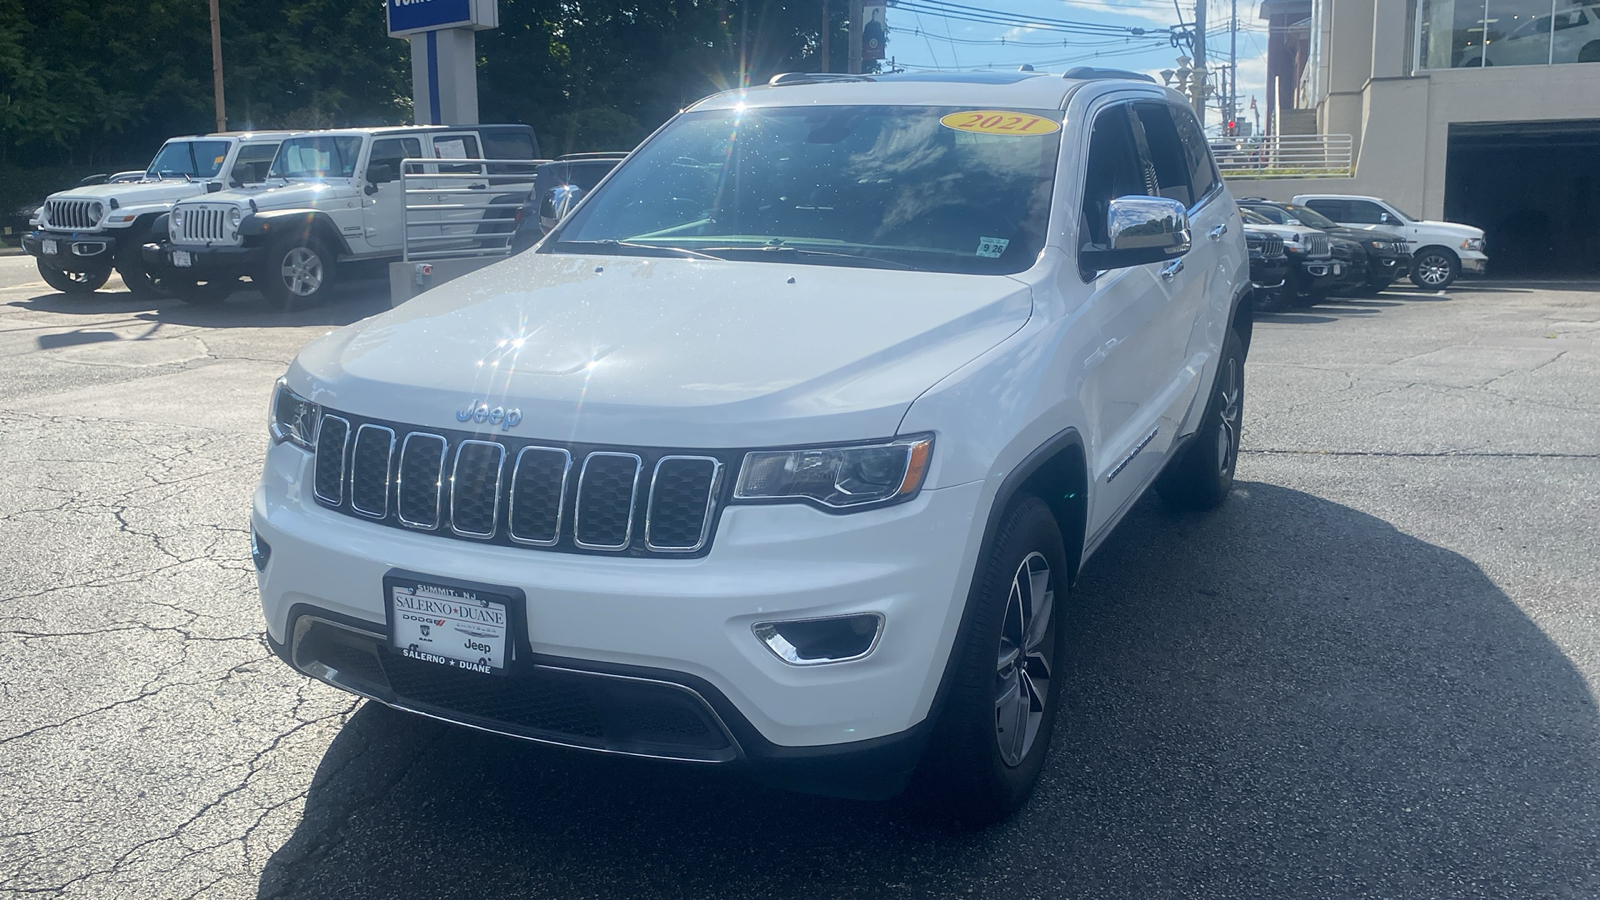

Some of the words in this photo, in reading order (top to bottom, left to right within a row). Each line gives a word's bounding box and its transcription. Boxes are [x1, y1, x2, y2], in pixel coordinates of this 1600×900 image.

[957, 114, 1040, 131] 2021
[983, 243, 990, 252] 9
[992, 244, 1003, 253] 26
[456, 399, 522, 432] Jeep
[417, 584, 458, 597] SUMMIT,
[463, 591, 476, 600] NJ
[396, 595, 452, 615] SALERNO
[459, 605, 504, 625] DUANE
[464, 638, 491, 654] Jeep
[403, 649, 445, 665] SALERNO
[459, 660, 491, 674] DUANE
